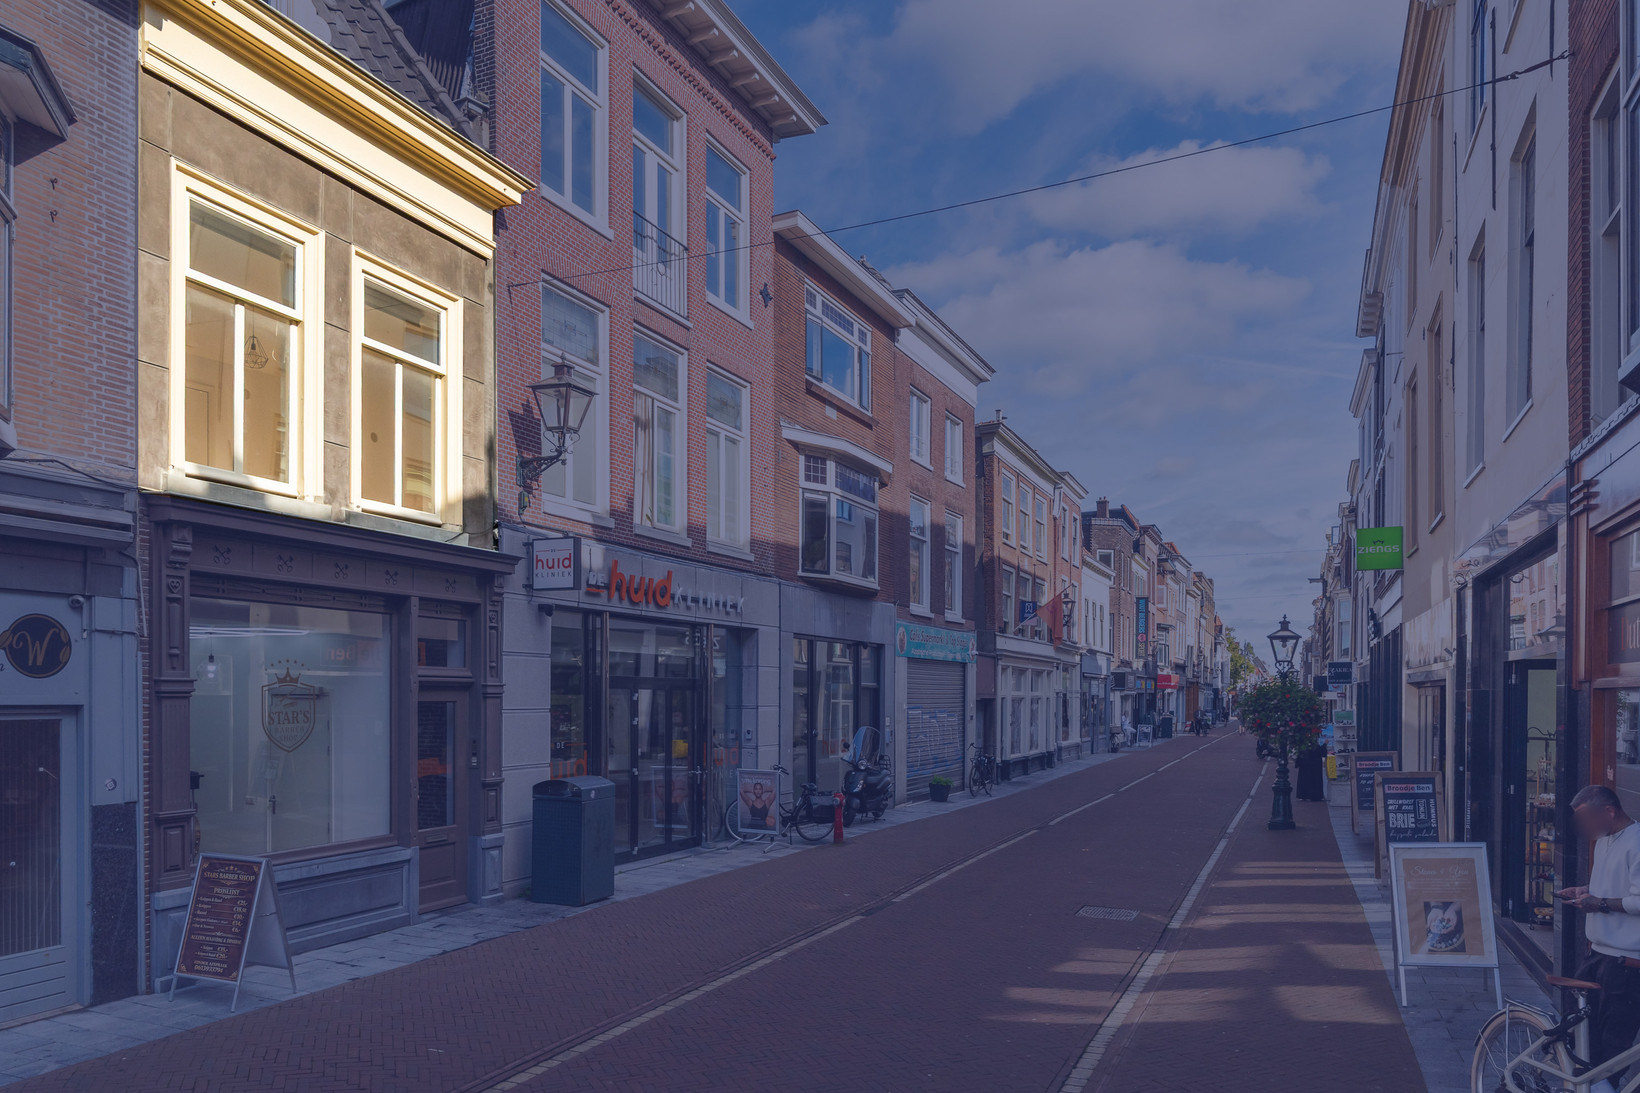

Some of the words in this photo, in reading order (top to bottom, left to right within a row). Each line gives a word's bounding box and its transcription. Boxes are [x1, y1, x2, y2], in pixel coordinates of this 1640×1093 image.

[1358, 545, 1400, 553] ZIENGS
[535, 553, 571, 570] huid
[588, 571, 604, 586] DE
[608, 559, 673, 607] huid
[674, 586, 745, 613] KLINIEK
[12, 627, 59, 666] W
[268, 710, 310, 726] STAR'S
[550, 749, 588, 780] uid
[1387, 784, 1415, 792] Broodje
[1389, 813, 1416, 828] BRIE
[1429, 799, 1437, 827] HUMMUS
[204, 871, 219, 879] STARS
[219, 872, 239, 880] BARBER
[239, 874, 256, 882] SHOP
